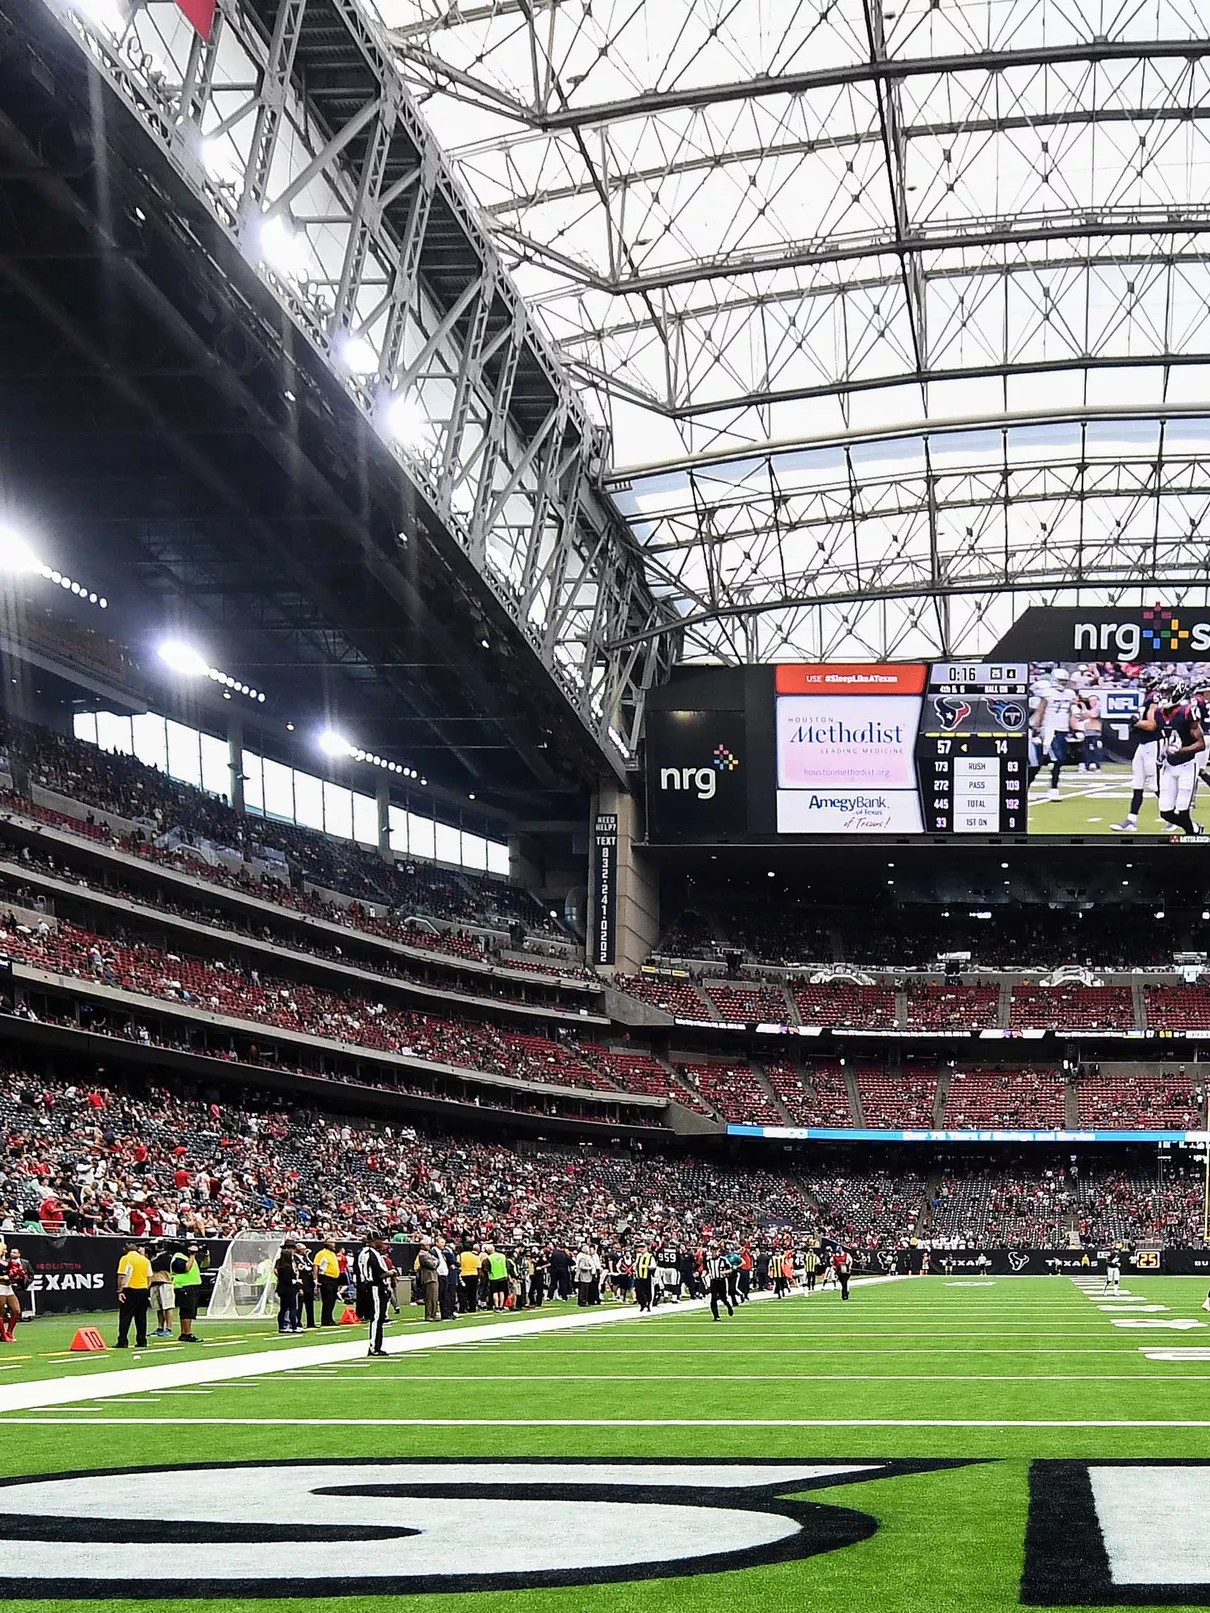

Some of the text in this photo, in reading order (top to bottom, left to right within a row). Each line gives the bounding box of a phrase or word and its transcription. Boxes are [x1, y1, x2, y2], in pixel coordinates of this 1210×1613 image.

[1073, 622, 1141, 661] nrg
[806, 675, 822, 683] USE
[949, 667, 976, 681] 0:16
[1108, 697, 1138, 711] NFL
[790, 721, 903, 744] Methodist
[937, 739, 952, 754] 57
[995, 739, 1008, 754] 14
[934, 761, 949, 772] 173
[803, 768, 890, 779] houstonmethodist.org
[661, 768, 716, 799] nrg
[933, 780, 949, 791] 272
[969, 781, 985, 789] PASS
[1005, 780, 1020, 791] 109
[809, 795, 889, 812] AmegyBank
[933, 799, 949, 810] 445
[967, 800, 985, 808] TOTAL
[1005, 799, 1020, 809] 192
[597, 816, 615, 824] NEED
[595, 823, 617, 832] HELP?
[595, 836, 616, 846] TEXT
[1139, 1254, 1158, 1267] 25
[84, 1331, 104, 1349] 10
